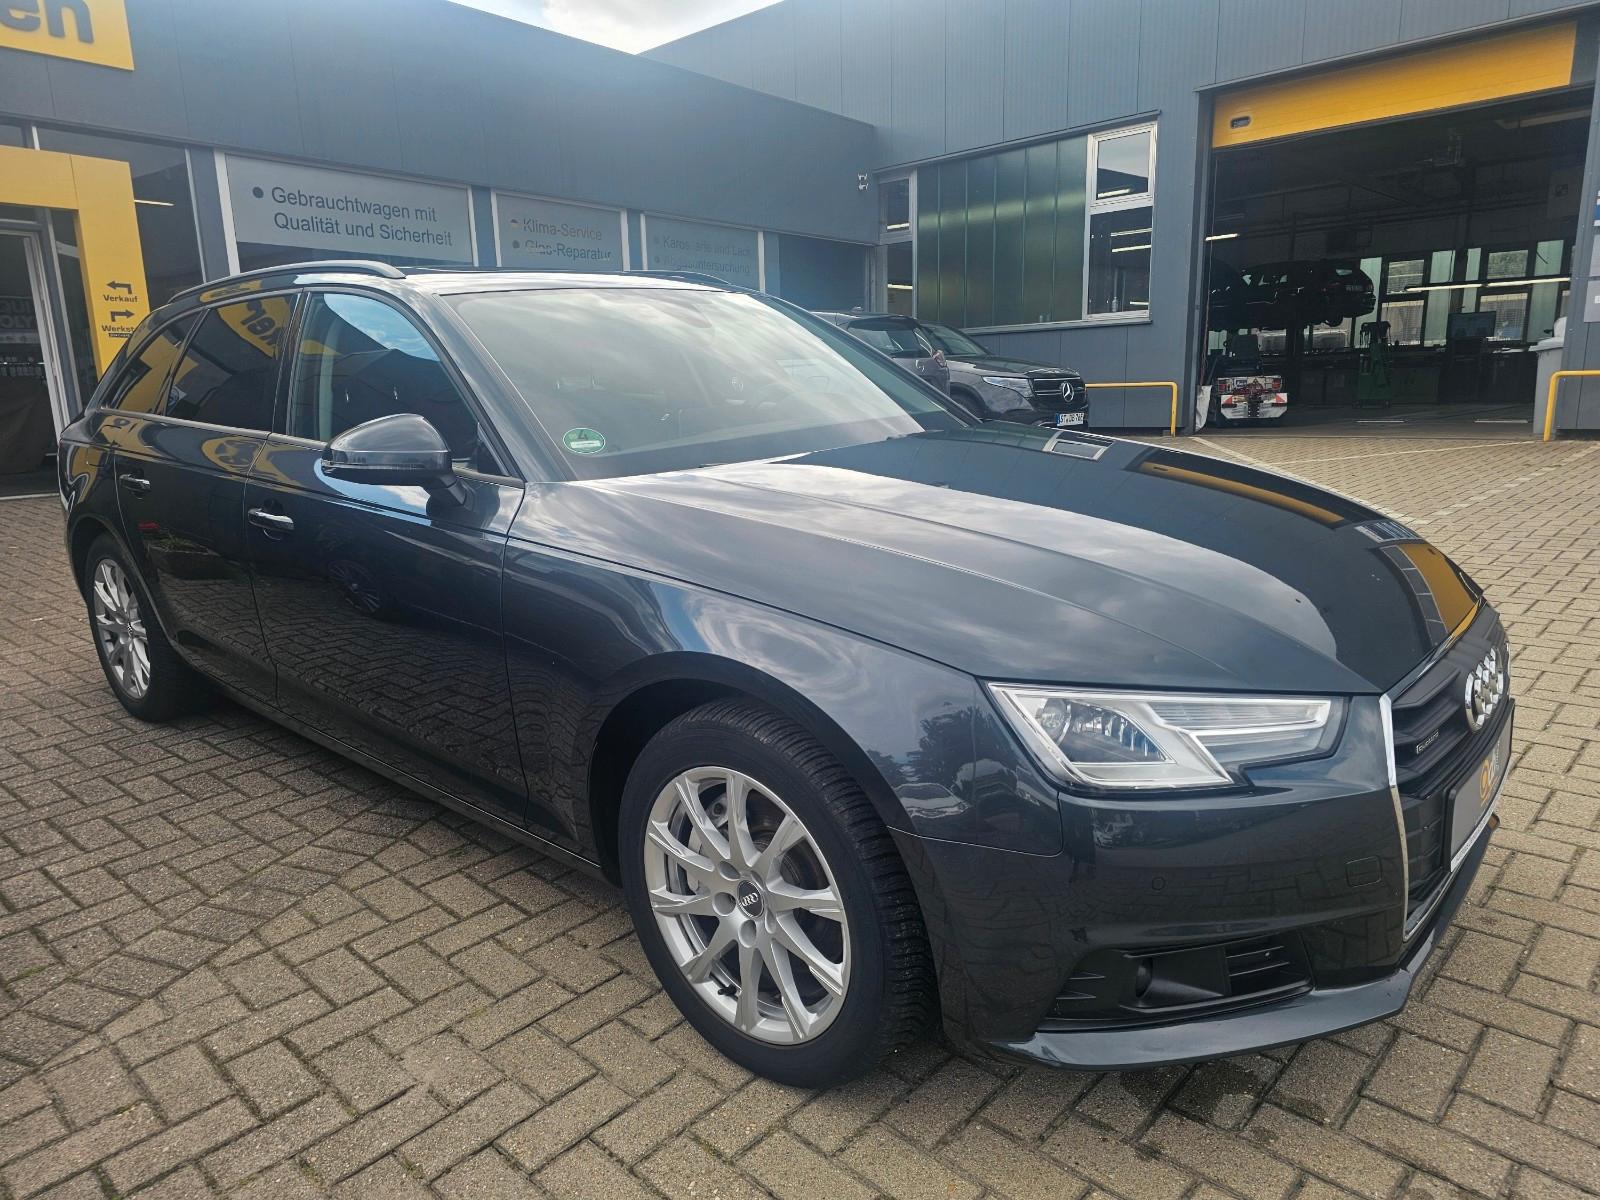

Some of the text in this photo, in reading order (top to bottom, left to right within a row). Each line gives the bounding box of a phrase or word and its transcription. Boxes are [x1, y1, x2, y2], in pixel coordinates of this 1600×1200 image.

[271, 186, 437, 223] Gebrauchtwagen mit
[273, 212, 453, 247] Qualität und Sicherheit
[523, 218, 603, 241] Klima-Service
[103, 294, 139, 303] Verkauf
[578, 429, 589, 440] 4
